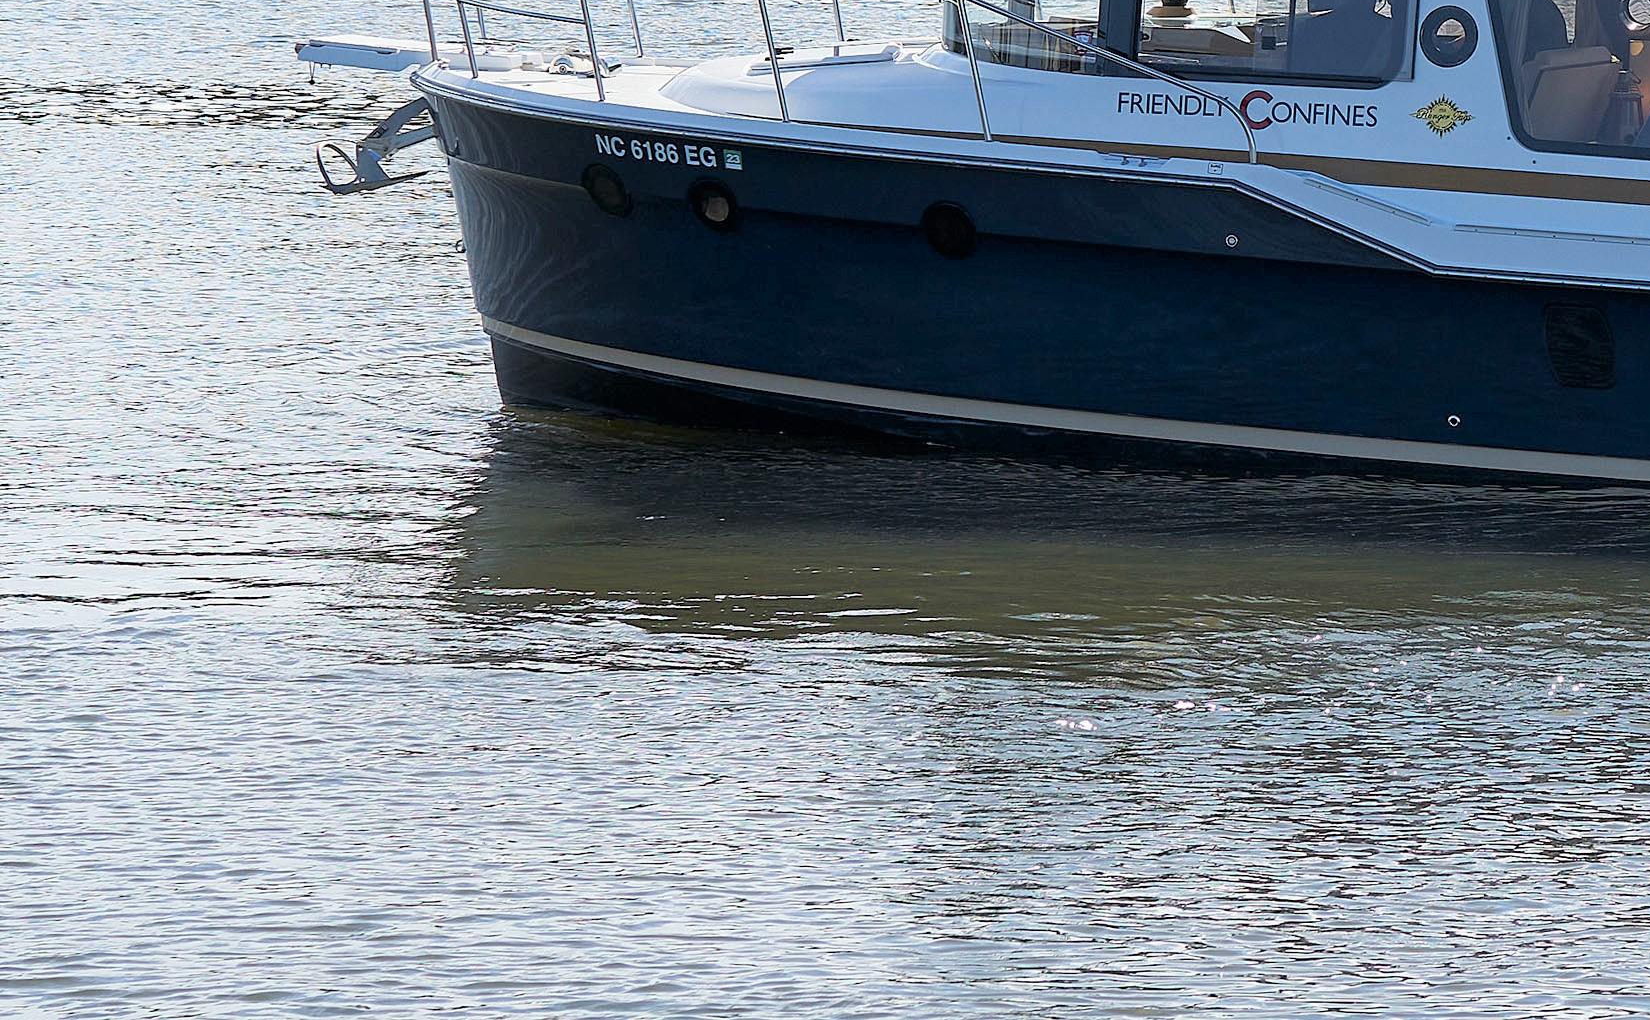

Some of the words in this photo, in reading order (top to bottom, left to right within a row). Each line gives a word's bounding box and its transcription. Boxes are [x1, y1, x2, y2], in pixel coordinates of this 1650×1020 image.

[1117, 92, 1229, 117] FRIENDLY
[1240, 89, 1379, 130] CONFINES
[594, 133, 626, 157] NC
[630, 139, 679, 164] 6186
[684, 144, 717, 168] EG
[725, 153, 741, 164] 23
